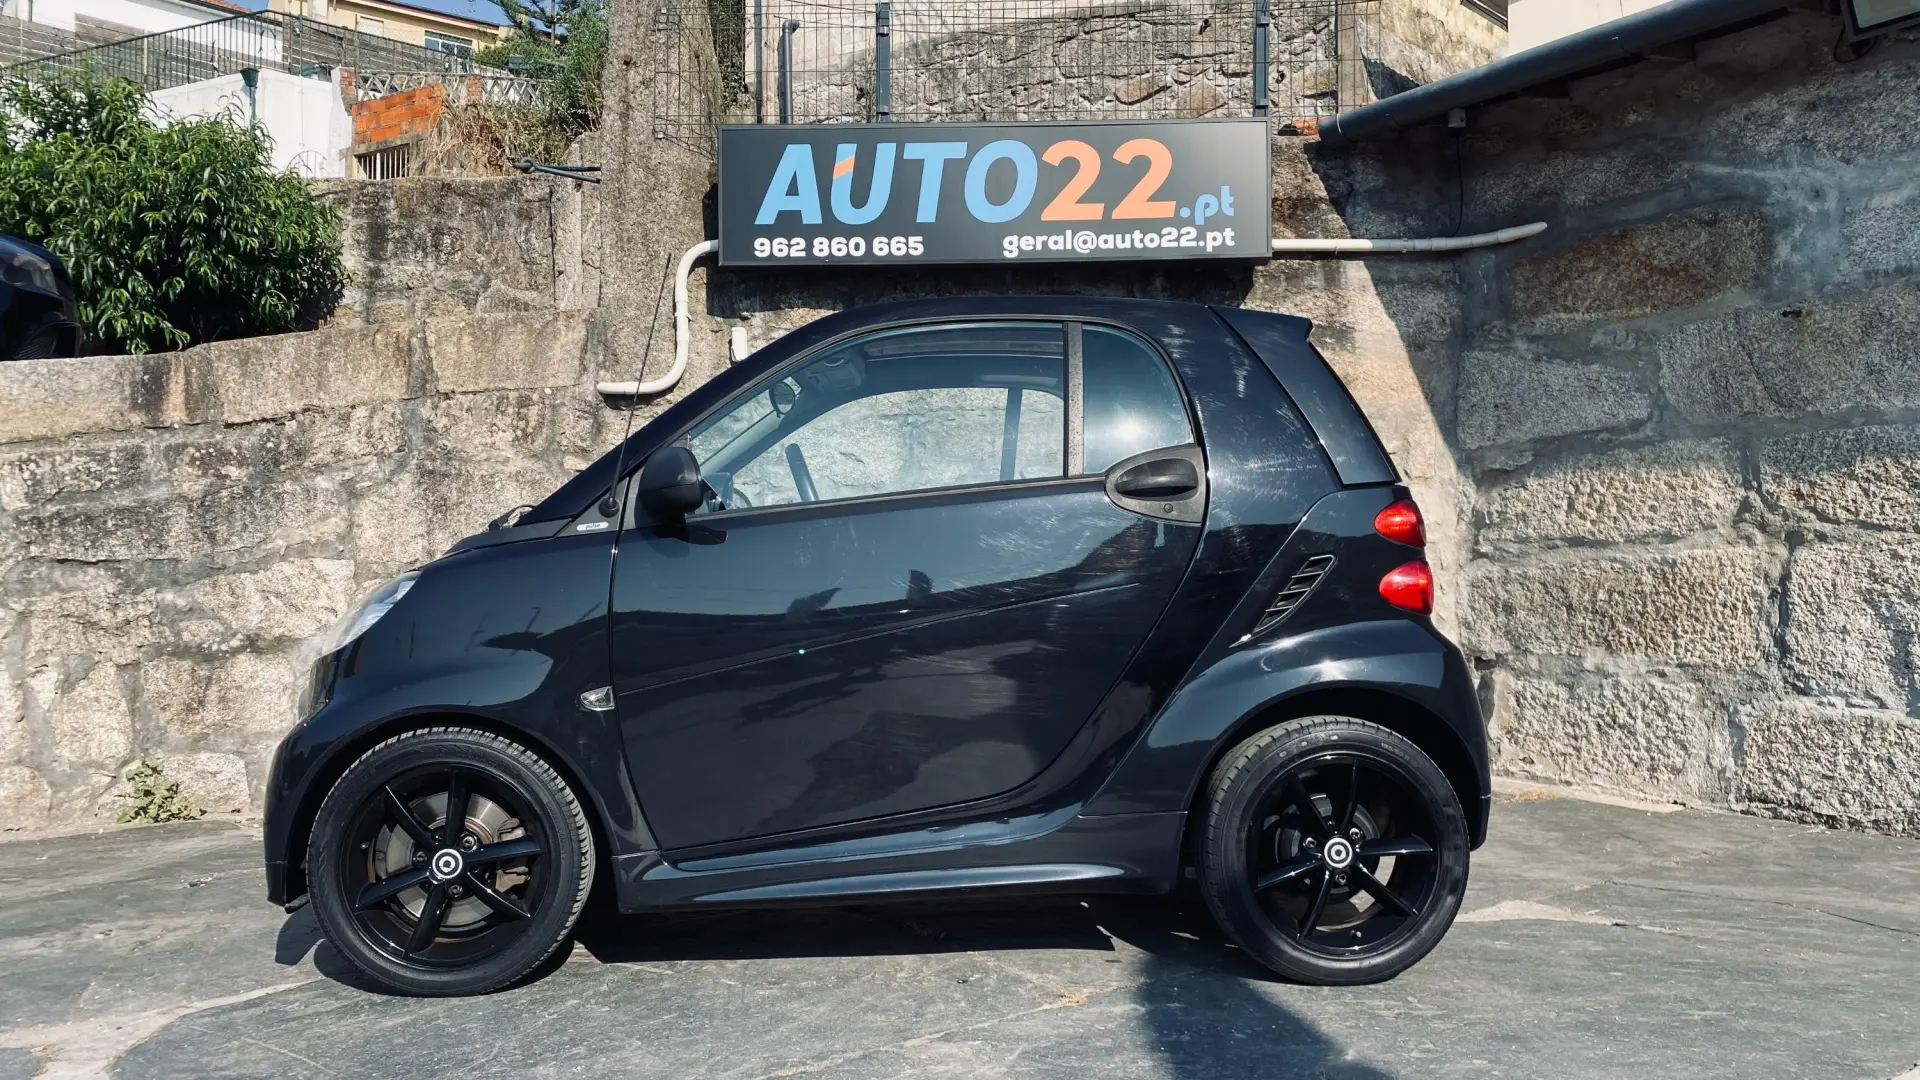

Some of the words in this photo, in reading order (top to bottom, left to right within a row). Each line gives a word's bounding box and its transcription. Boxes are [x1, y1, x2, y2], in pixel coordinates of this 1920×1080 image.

[755, 138, 1235, 225] AUTO22.pt
[754, 237, 806, 257] 962
[812, 237, 866, 257] 860
[872, 236, 925, 257] 665
[1002, 226, 1235, 259] geral@auto22.pt
[585, 522, 601, 530] pulse
